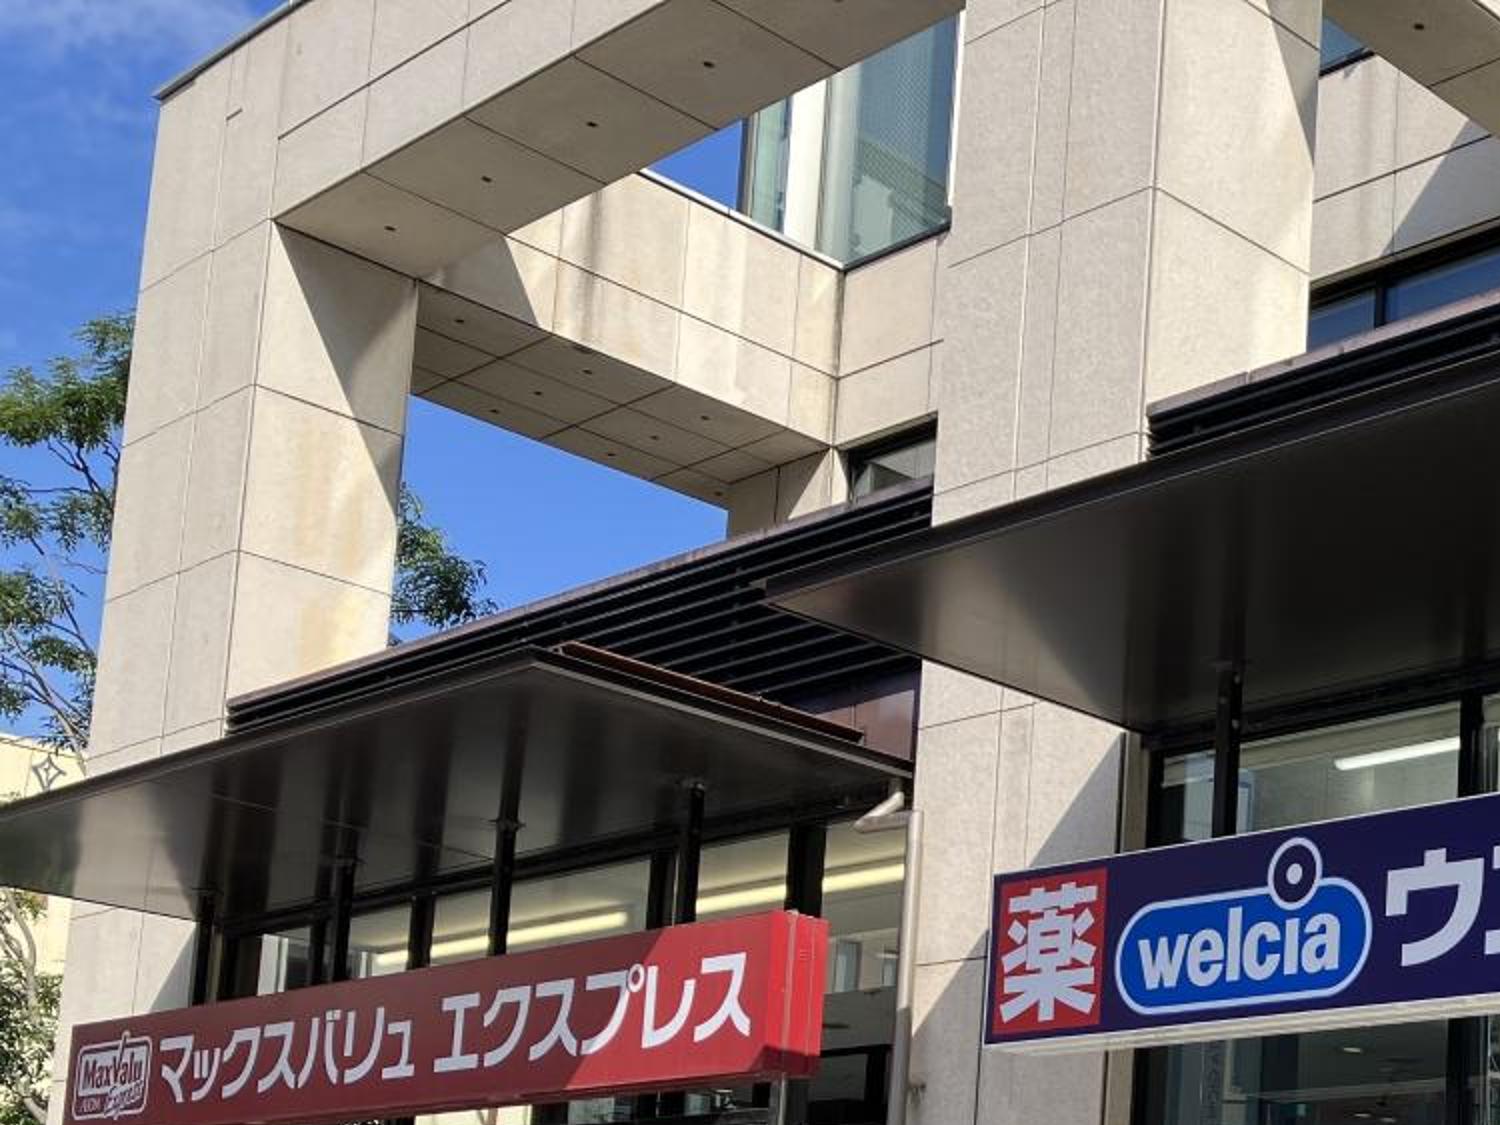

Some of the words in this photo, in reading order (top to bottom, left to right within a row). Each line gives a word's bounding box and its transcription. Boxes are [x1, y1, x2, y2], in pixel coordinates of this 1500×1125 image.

[999, 881, 1097, 1023] 薬
[1137, 864, 1340, 991] welcia
[160, 1006, 415, 1103] マックスバリュ
[433, 951, 750, 1073] エクスプレス
